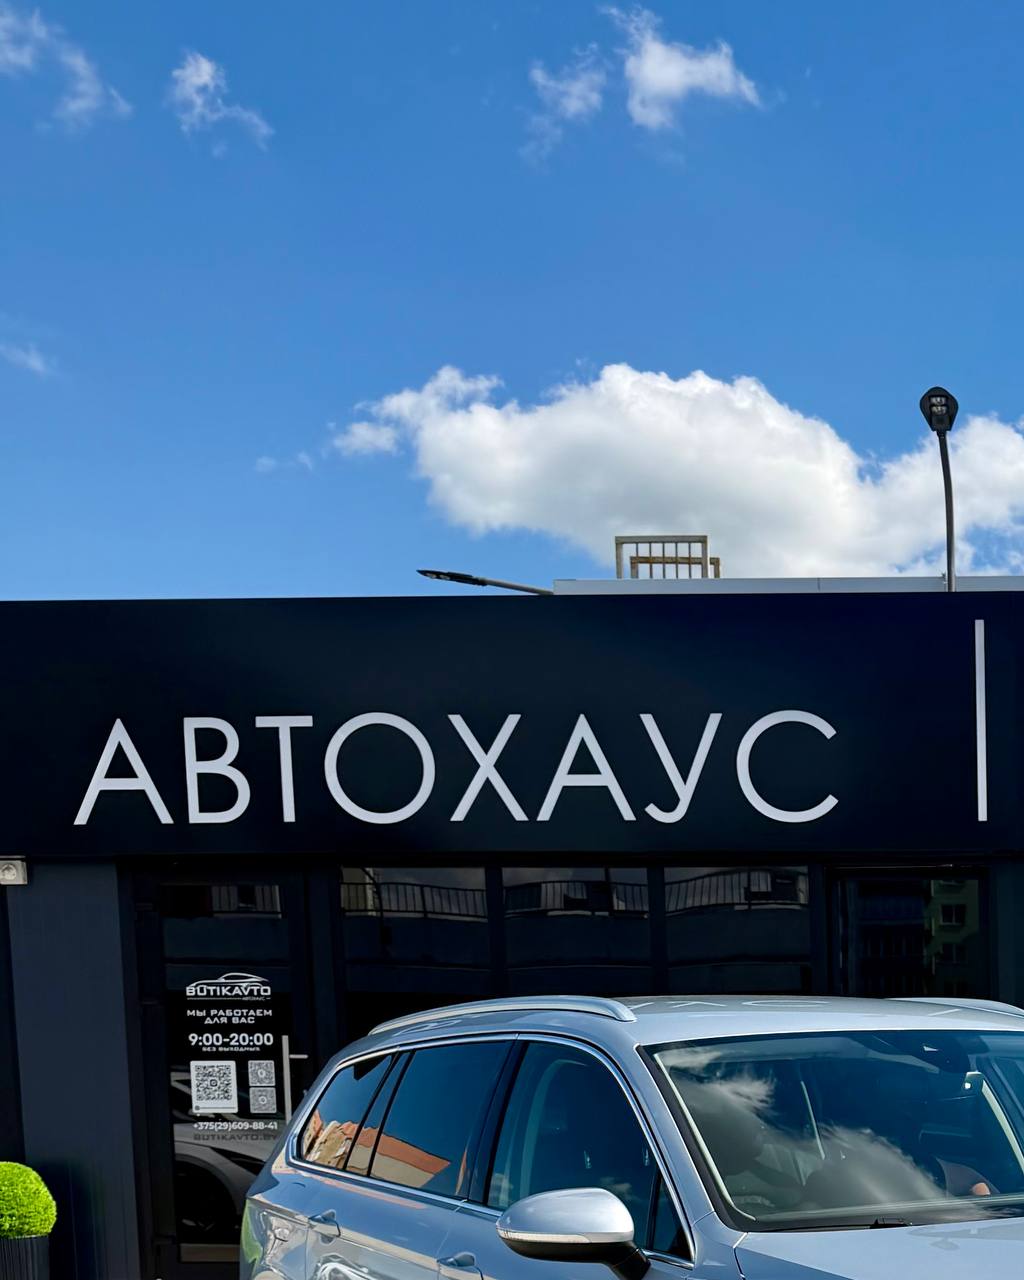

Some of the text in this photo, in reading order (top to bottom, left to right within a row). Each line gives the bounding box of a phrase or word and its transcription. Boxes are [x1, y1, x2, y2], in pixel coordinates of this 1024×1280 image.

[73, 710, 840, 826] АВТОХАУС
[185, 985, 272, 997] BUTIKAVTO
[187, 1009, 273, 1017] МЫ РАБОТАЕМ
[232, 1016, 255, 1024] ВАС
[188, 1033, 274, 1046] 9:00-20:00
